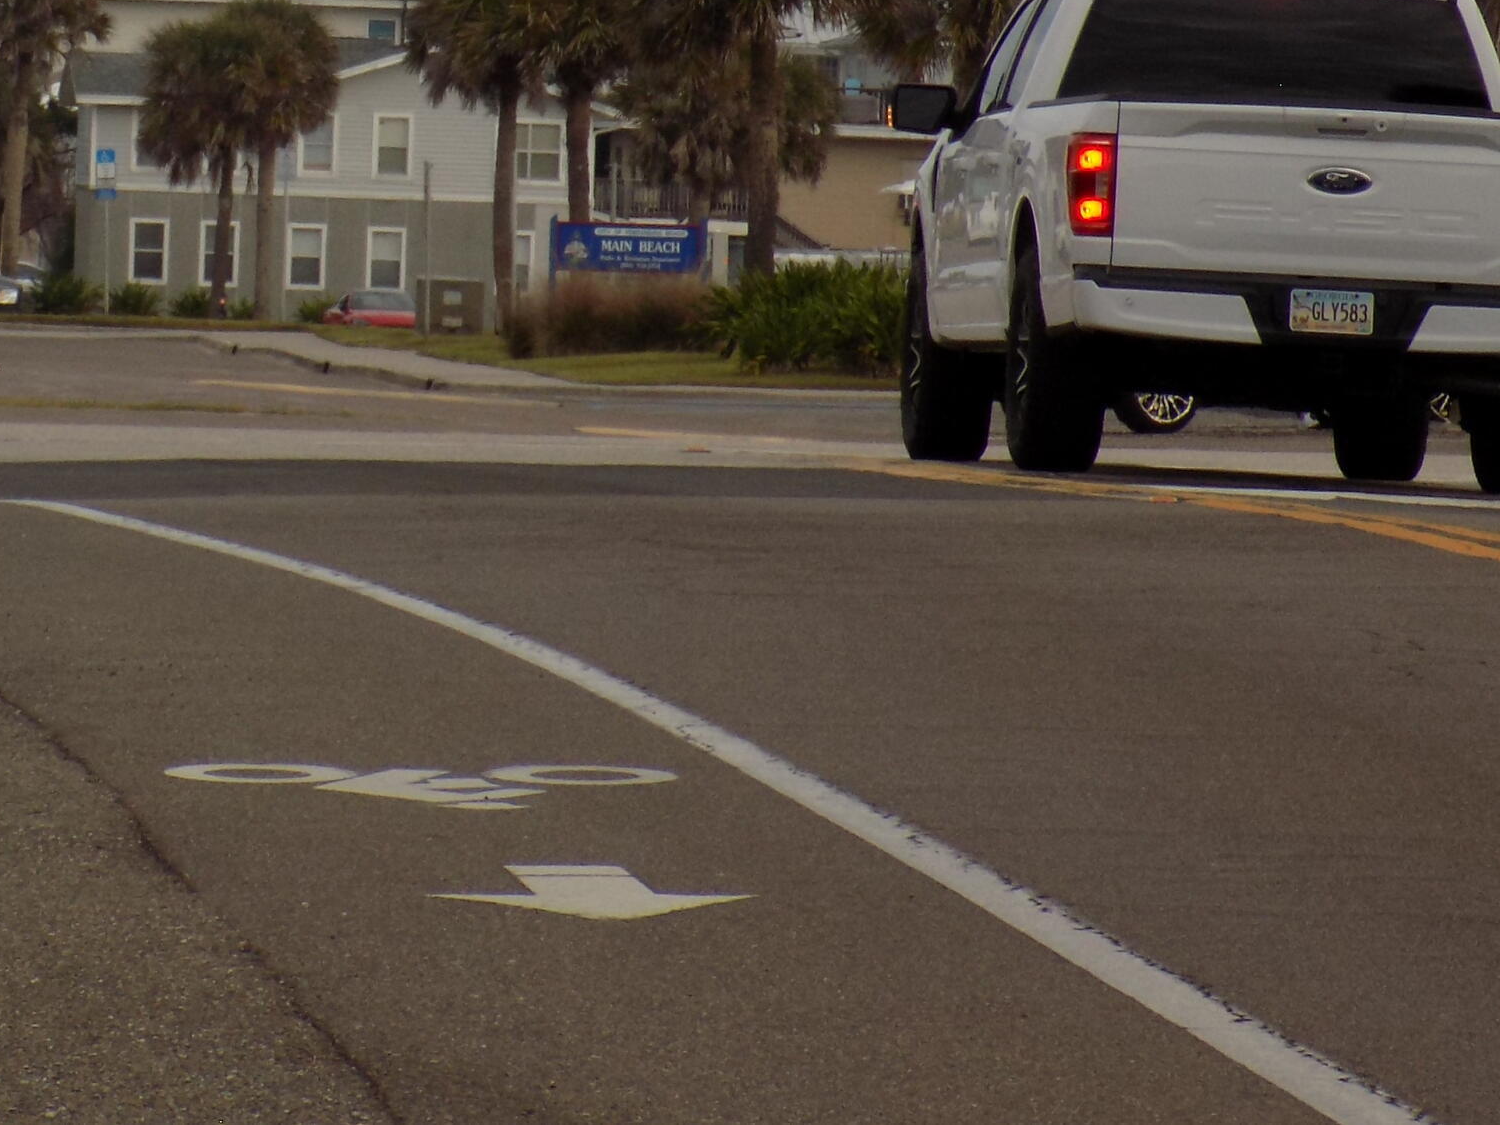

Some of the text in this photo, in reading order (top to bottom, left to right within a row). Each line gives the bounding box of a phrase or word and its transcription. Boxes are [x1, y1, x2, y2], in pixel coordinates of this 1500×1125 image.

[601, 240, 680, 253] MAIN BEACH
[1311, 301, 1368, 323] GLY583
